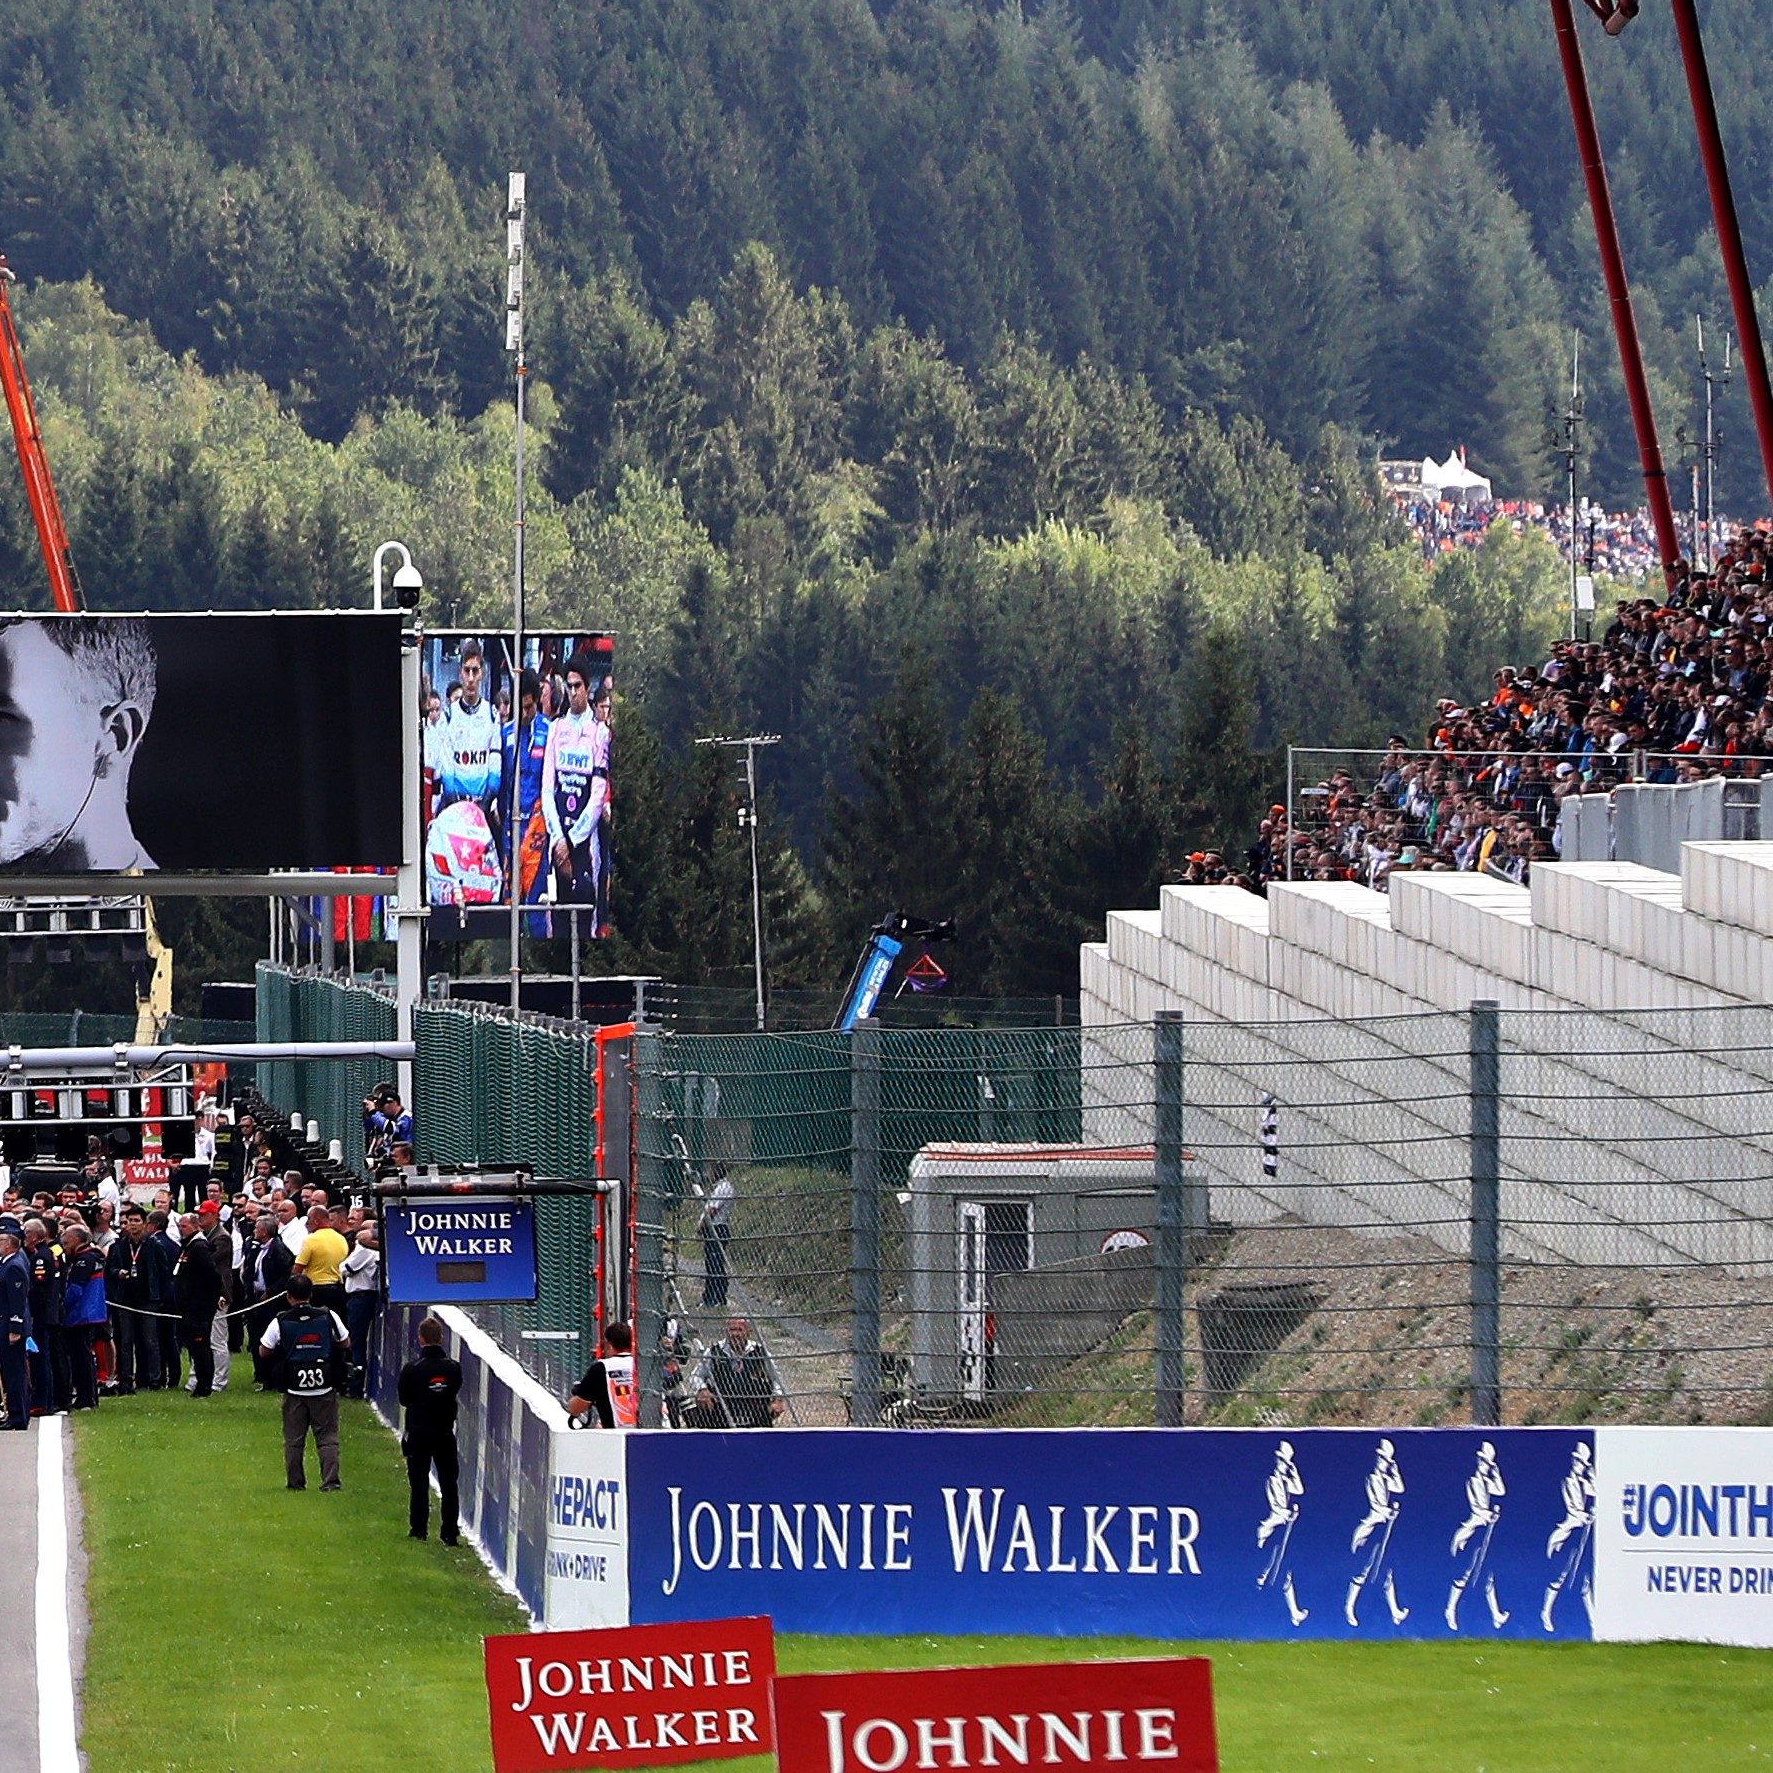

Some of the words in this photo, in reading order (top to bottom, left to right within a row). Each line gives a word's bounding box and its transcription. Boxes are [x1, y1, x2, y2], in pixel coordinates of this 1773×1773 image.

[349, 1194, 364, 1208] 16
[406, 1211, 512, 1235] JOHNNIE
[415, 1236, 513, 1255] WALKER
[297, 1368, 325, 1388] 233
[662, 1487, 912, 1595] JOHNNIE
[941, 1488, 1202, 1575] WALKER
[1647, 1565, 1722, 1595] NEVER
[512, 1650, 751, 1712] JOHNNIE
[529, 1708, 759, 1755] WALKER
[821, 1708, 1178, 1773] JOHNNIE
